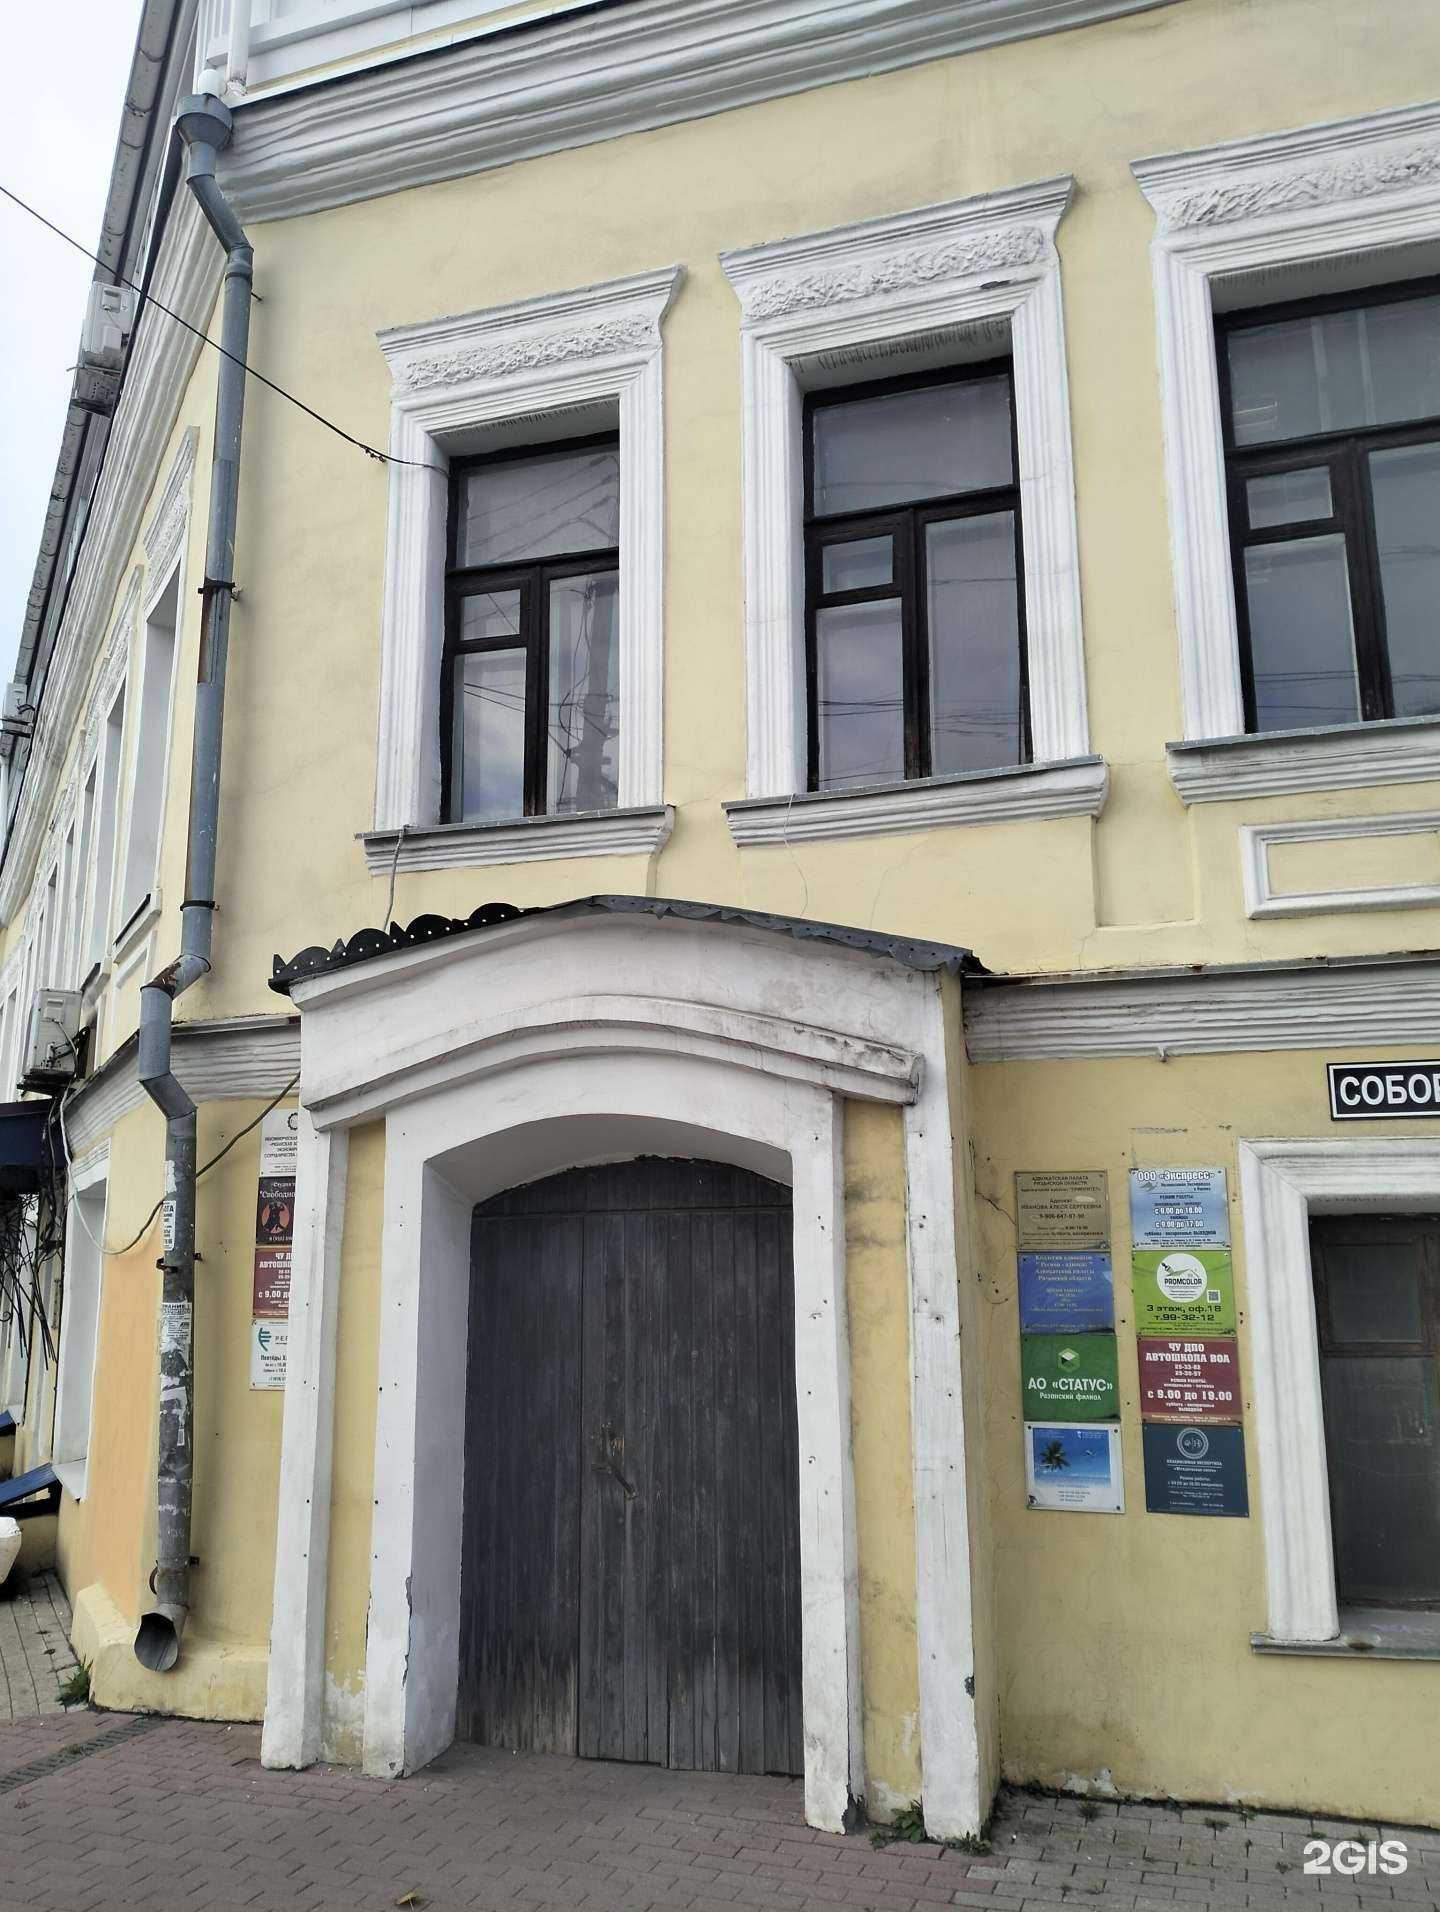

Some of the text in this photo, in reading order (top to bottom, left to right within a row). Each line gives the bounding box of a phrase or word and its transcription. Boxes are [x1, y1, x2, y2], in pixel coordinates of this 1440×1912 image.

[1138, 1172, 1156, 1181] ООО
[1189, 1305, 1222, 1313] оф.18
[1168, 1343, 1204, 1353] ЧУ ДПО
[1145, 1353, 1230, 1363] АВТОШКОЛА ВОА
[1028, 1377, 1113, 1391] АО «СТАТУС»
[1040, 1392, 1101, 1402] Рязанский филиал
[1157, 1390, 1181, 1399] 9.00
[1185, 1392, 1198, 1400] до
